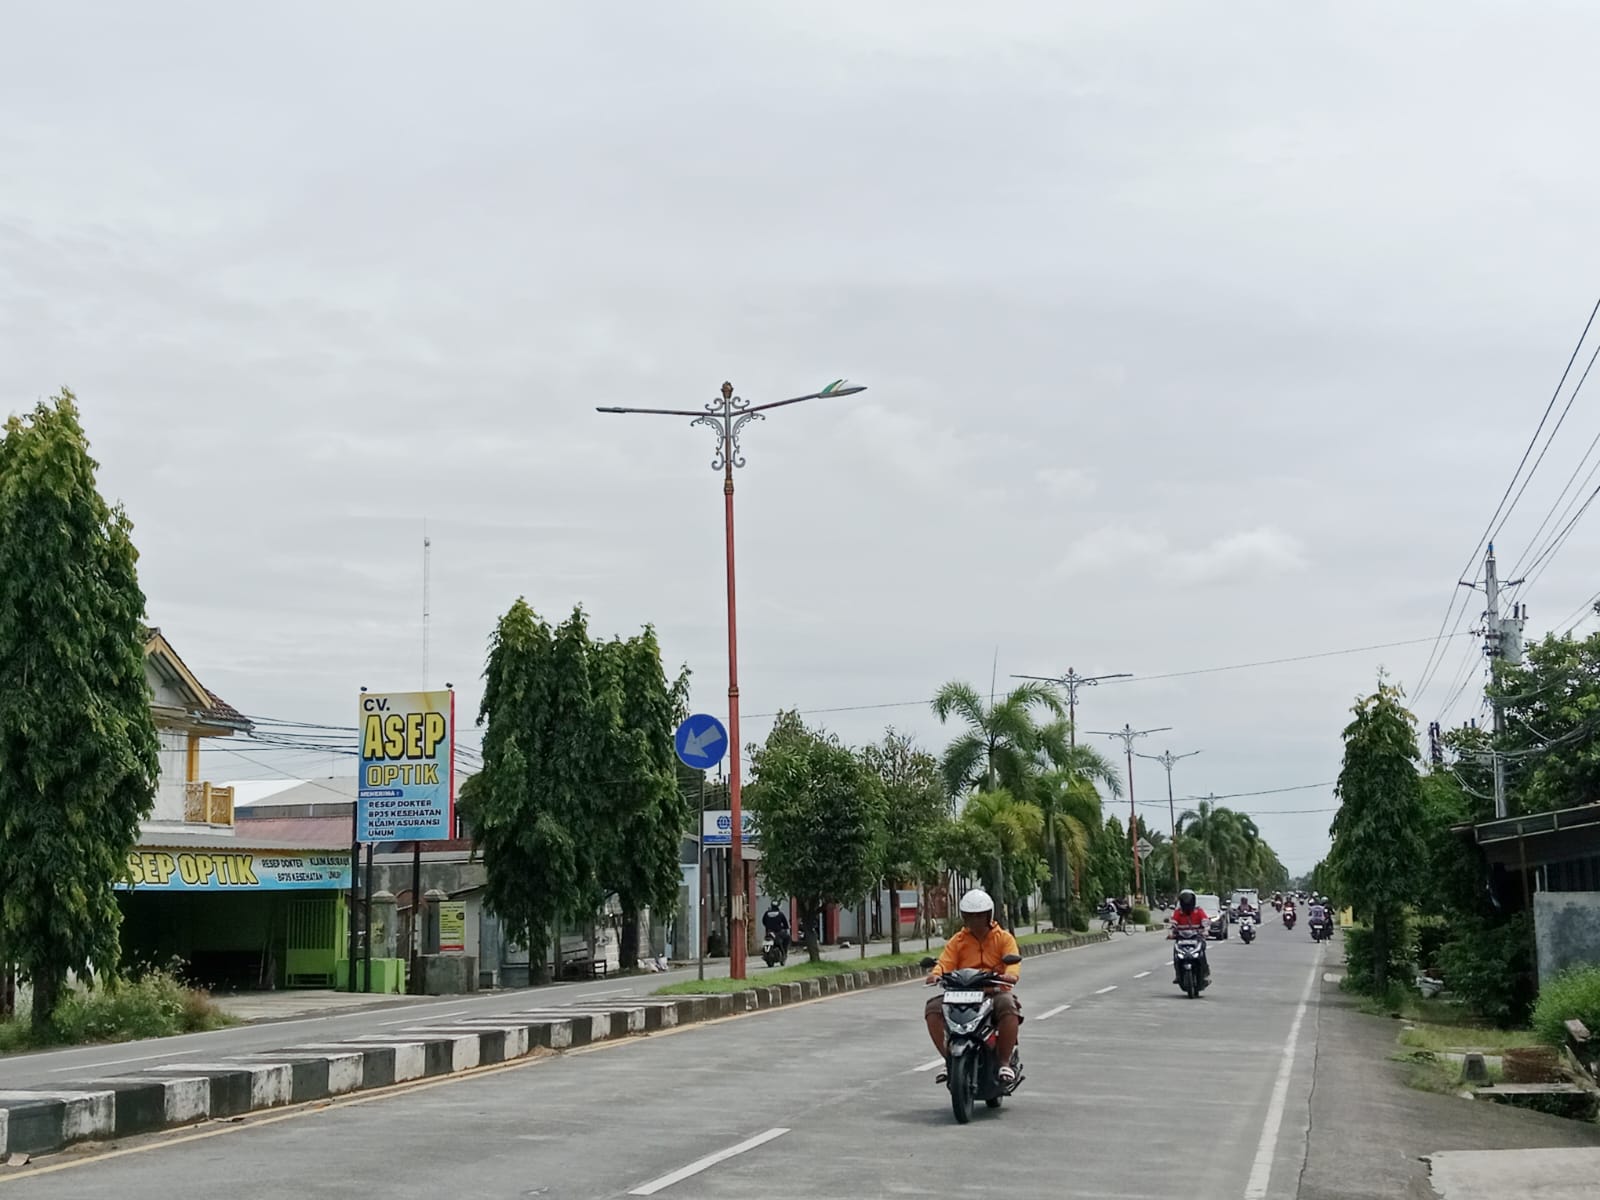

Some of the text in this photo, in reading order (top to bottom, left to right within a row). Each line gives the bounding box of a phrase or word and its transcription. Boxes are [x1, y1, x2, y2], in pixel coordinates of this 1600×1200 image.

[363, 698, 390, 712] CV.
[363, 712, 446, 761] ASEP
[366, 763, 440, 786] OPTIK
[390, 809, 442, 817] KESEHATAN
[120, 852, 260, 885] SEP OPTIK
[261, 859, 304, 868] RESEP DOKTER
[292, 872, 323, 881] KESEHATAN
